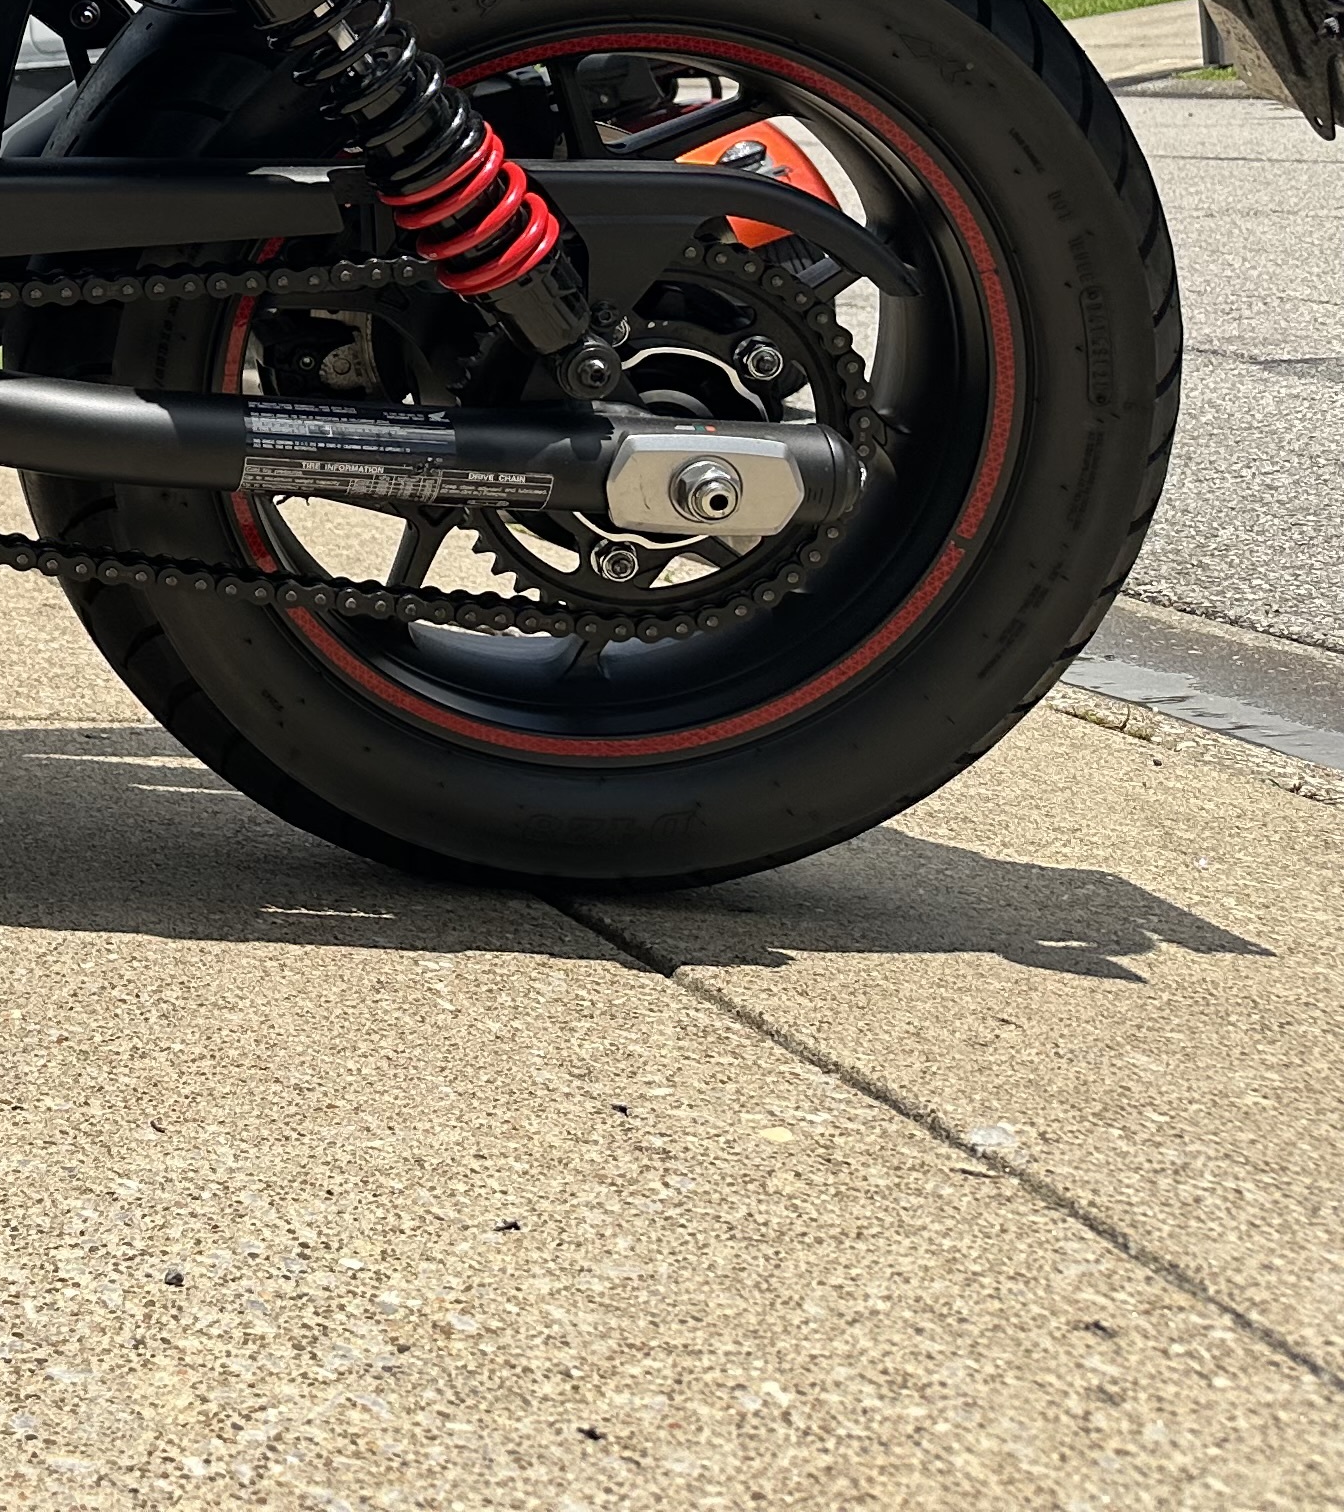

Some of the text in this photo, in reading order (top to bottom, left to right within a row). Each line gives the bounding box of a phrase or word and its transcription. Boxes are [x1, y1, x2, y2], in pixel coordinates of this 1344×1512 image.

[301, 461, 320, 471] TIRE
[324, 463, 385, 474] INFORMATION
[498, 474, 526, 484] CHAIN
